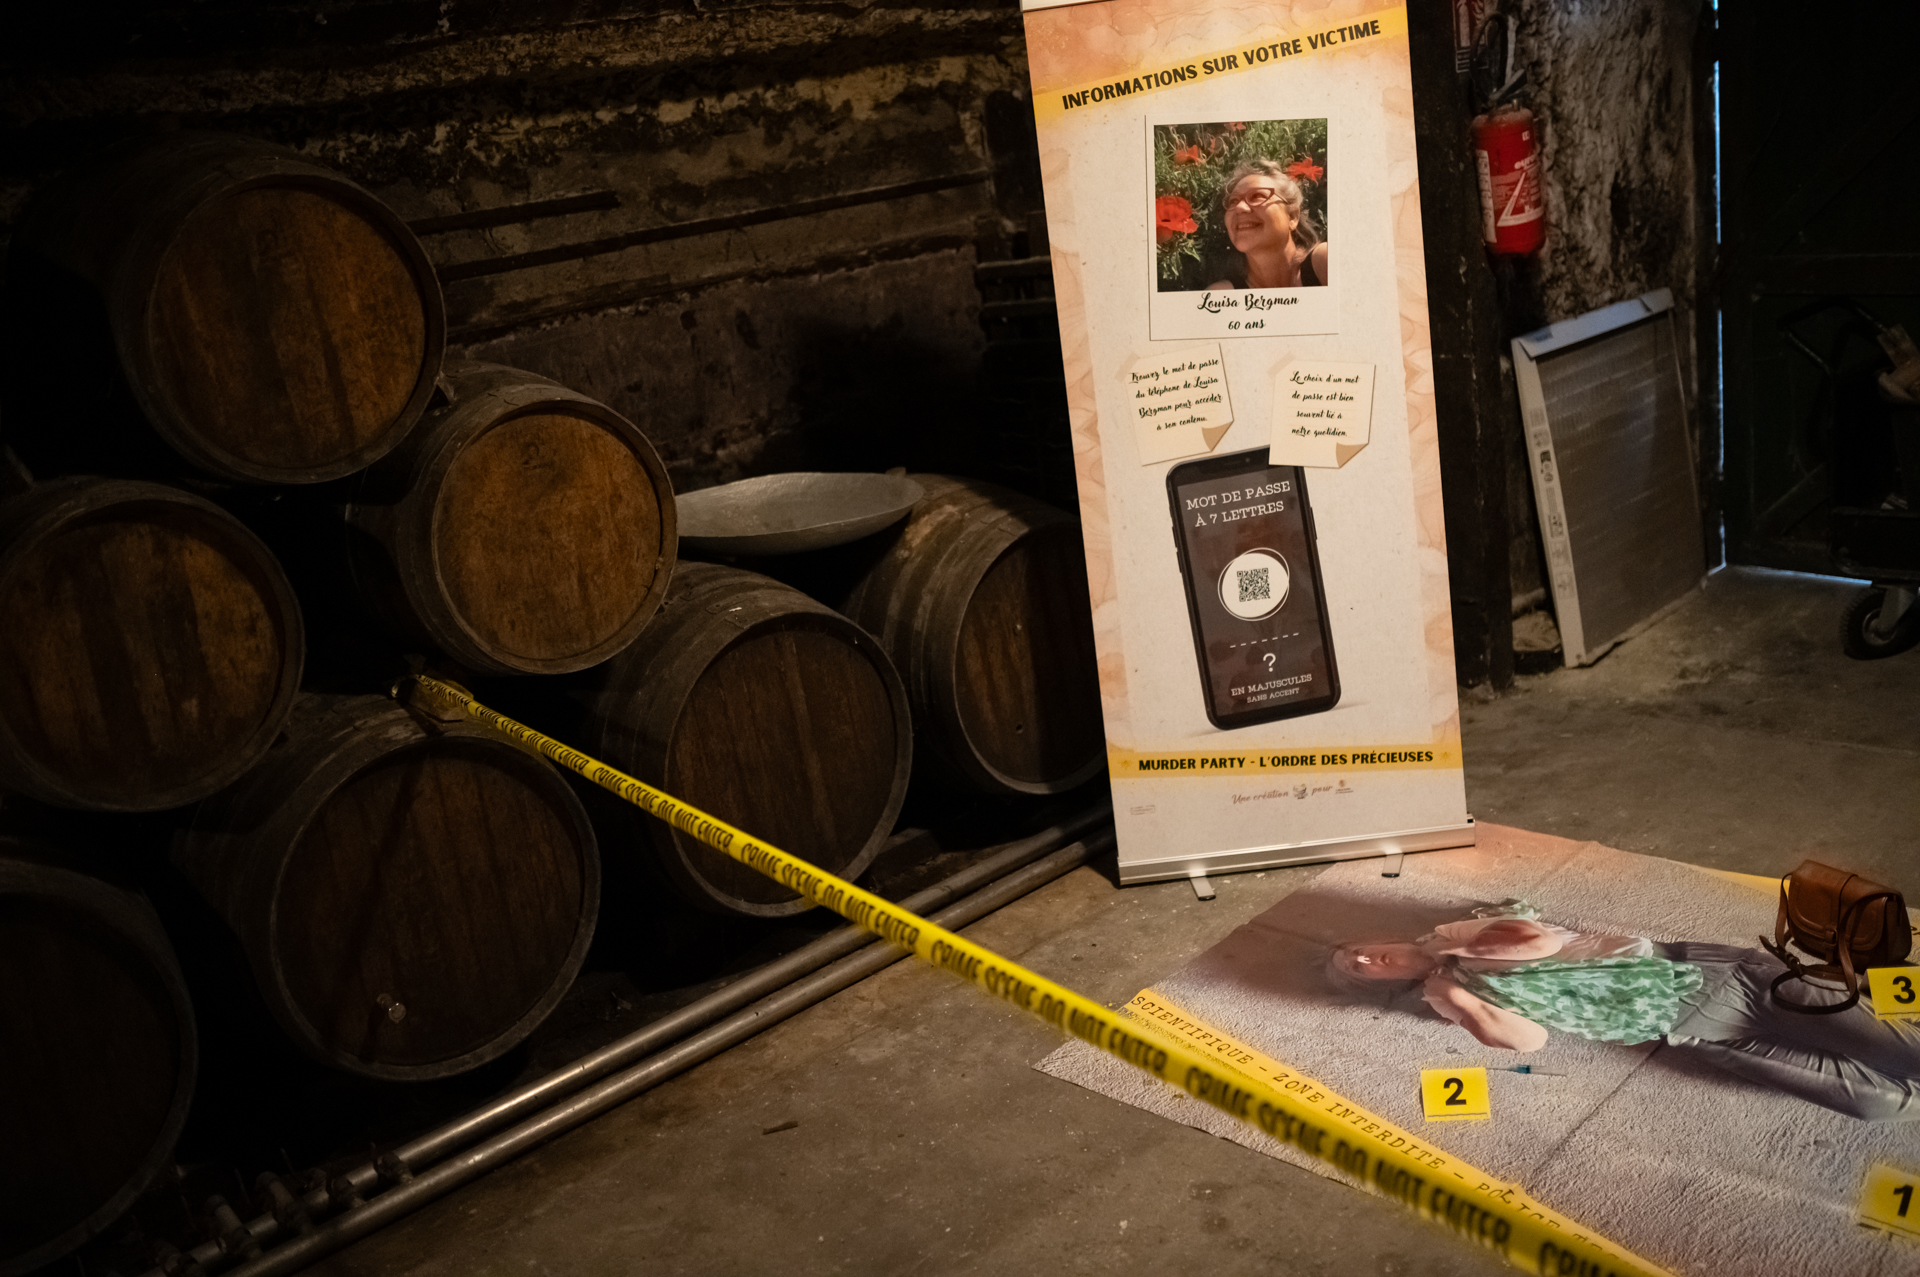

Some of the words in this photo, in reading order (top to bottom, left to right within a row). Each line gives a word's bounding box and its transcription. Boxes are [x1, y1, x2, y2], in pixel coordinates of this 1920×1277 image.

[1062, 64, 1198, 110] INFORMATIONS
[1202, 54, 1239, 76] SUR
[1243, 38, 1303, 66] VOTRE
[1307, 19, 1381, 51] VICTIME
[1197, 292, 1240, 313] Louisa
[1244, 293, 1299, 311] Bergman
[1228, 321, 1240, 330] 60
[1245, 319, 1266, 329] ans
[1128, 371, 1160, 384] Trouvez
[1162, 366, 1169, 375] le
[1172, 363, 1186, 373] mot
[1188, 361, 1196, 370] de
[1199, 358, 1219, 371] passe
[1290, 371, 1304, 385] Le
[1304, 373, 1323, 382] choix
[1345, 375, 1359, 383] mot
[1136, 390, 1145, 398] du
[1183, 380, 1191, 389] de
[1193, 376, 1218, 389] Louisa
[1292, 390, 1300, 399] de
[1303, 393, 1323, 402] passe
[1326, 392, 1338, 401] est
[1339, 392, 1354, 401] bien
[1138, 405, 1172, 418] Bergman
[1174, 399, 1192, 412] pour
[1195, 393, 1222, 405] accéder
[1296, 409, 1324, 418] souvent
[1165, 421, 1177, 430] son
[1291, 425, 1311, 437] notre
[1186, 495, 1218, 510] MOT
[1221, 490, 1242, 504] DE
[1245, 481, 1291, 499] PASSE
[1194, 513, 1207, 527] À
[1209, 513, 1218, 525] 7
[1222, 500, 1285, 523] LETTRES
[1262, 653, 1276, 673] ?
[1231, 686, 1245, 697] EN
[1247, 673, 1312, 694] MAJUSCULES
[1247, 693, 1268, 704] SANS
[1269, 687, 1300, 700] ACCENT
[1138, 758, 1196, 771] MURDER
[1200, 756, 1246, 770] PARTY
[1259, 754, 1317, 768] L'ORDRE
[1321, 753, 1348, 766] DES
[1351, 750, 1433, 765] PRÉCIEUSES
[1231, 794, 1251, 805] Une
[1311, 784, 1333, 796] pour
[1891, 976, 1916, 1004] 3
[1131, 996, 1254, 1065] SCIENTIFIQUE
[1272, 1072, 1325, 1103] ZONE
[1325, 1102, 1446, 1169] INTERDITE
[1442, 1077, 1467, 1107] 2
[1892, 1184, 1914, 1218] 1
